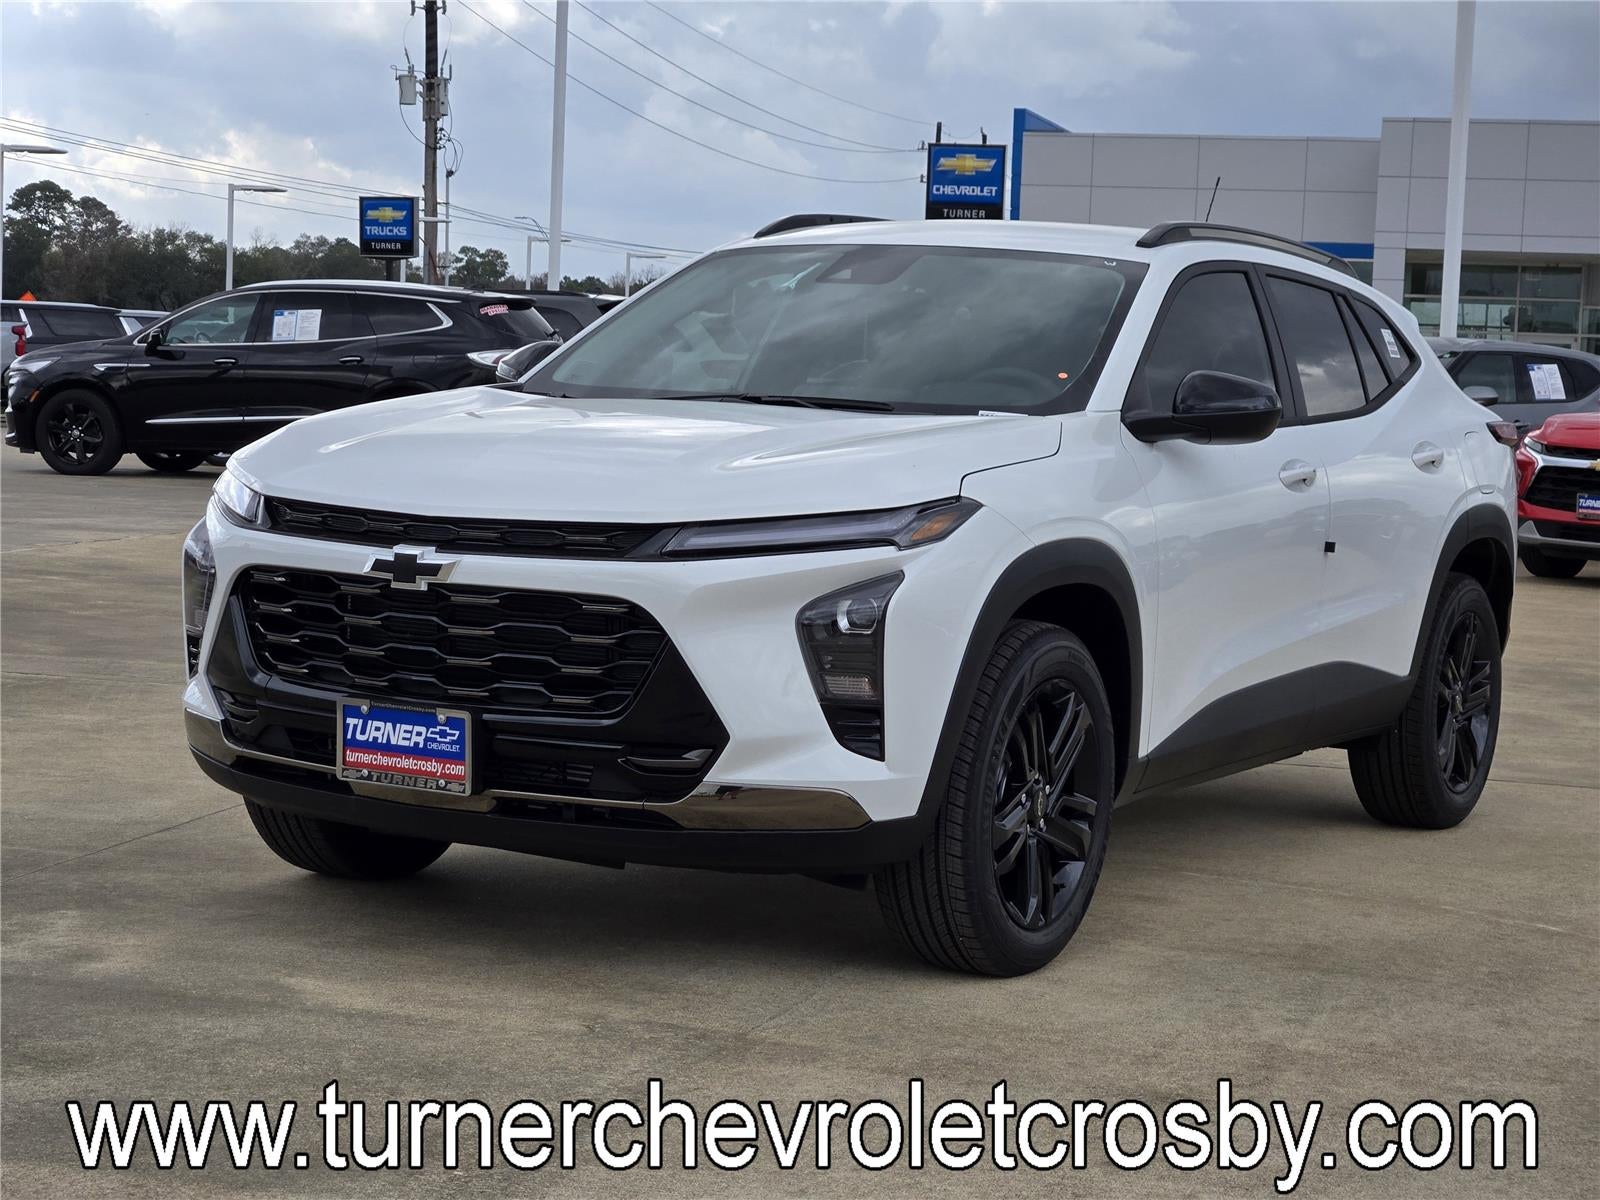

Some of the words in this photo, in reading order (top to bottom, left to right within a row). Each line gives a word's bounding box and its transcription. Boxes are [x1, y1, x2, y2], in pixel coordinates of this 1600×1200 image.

[932, 184, 998, 197] CHEVROLET
[943, 208, 986, 219] TURNER
[365, 226, 407, 236] TRUCKS
[371, 242, 401, 250] TURNER
[346, 717, 426, 748] TURNER
[427, 742, 460, 752] CHEVROLET
[346, 749, 465, 776] turnerchevroletcrosby.com
[371, 772, 437, 789] TURNER
